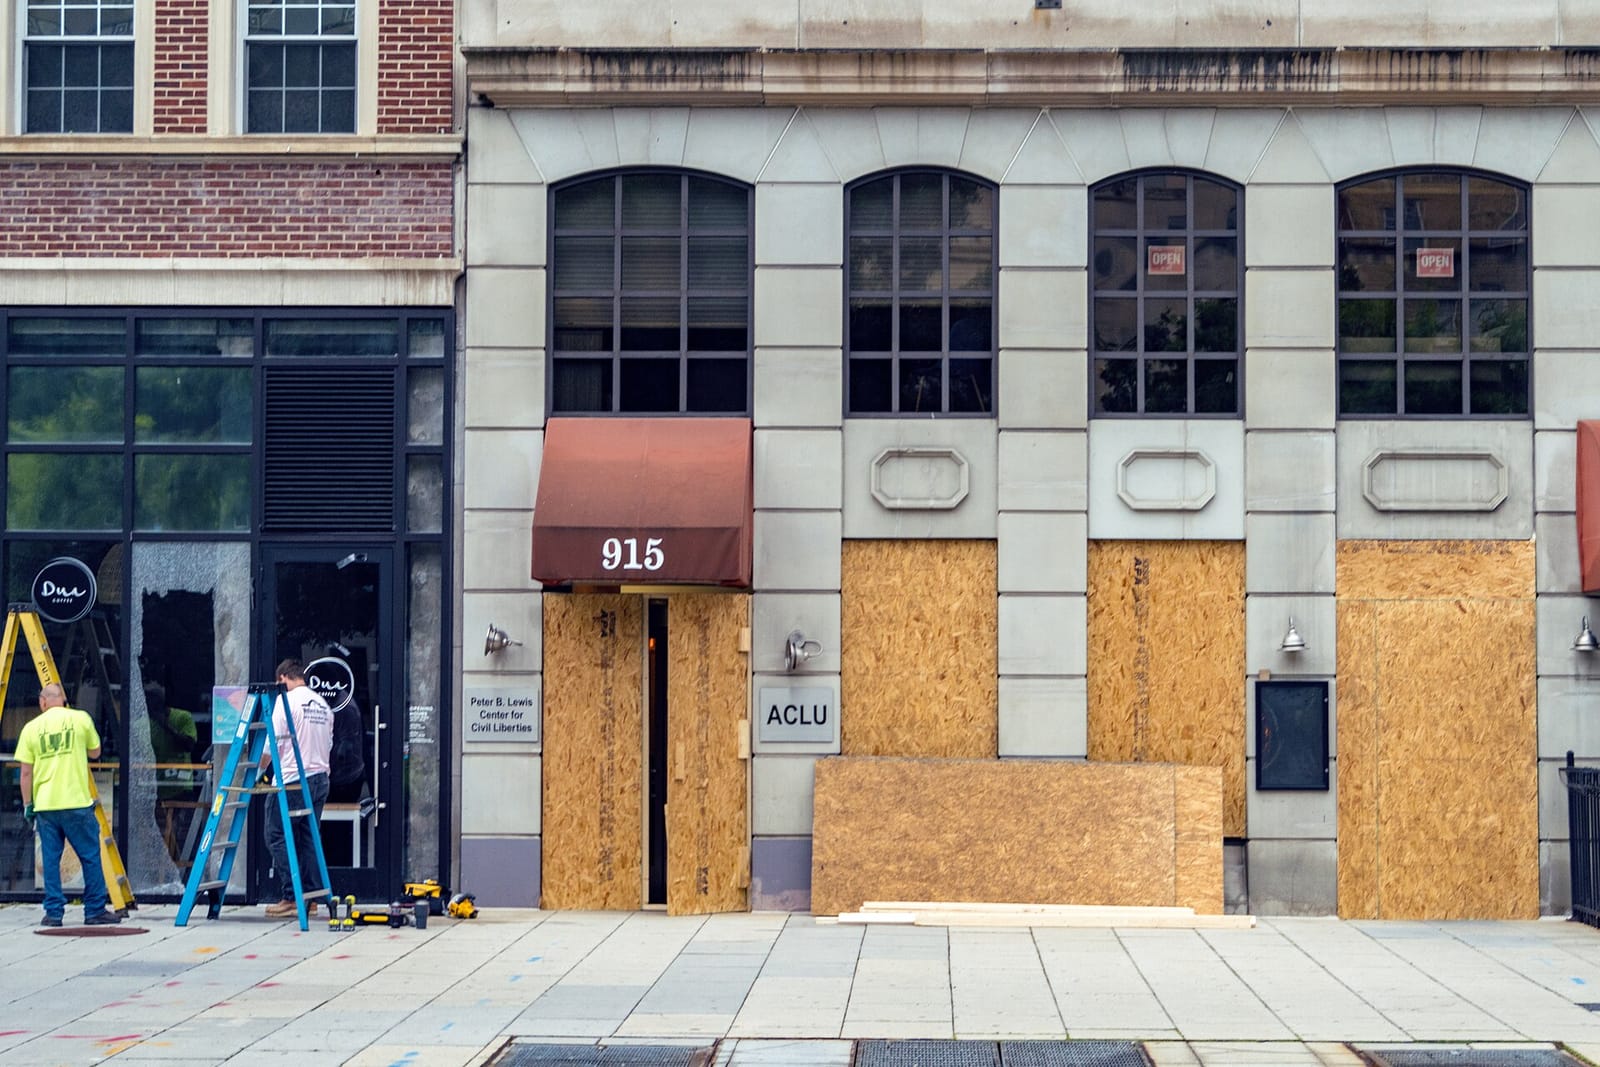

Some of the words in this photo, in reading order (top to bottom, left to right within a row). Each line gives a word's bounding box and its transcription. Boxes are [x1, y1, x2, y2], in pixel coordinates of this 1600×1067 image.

[1152, 252, 1181, 265] OPEN
[1421, 255, 1450, 267] OPEN
[602, 537, 664, 571] 915
[470, 697, 493, 707] Peter
[496, 697, 505, 707] B.
[507, 697, 533, 707] Lewis
[480, 709, 509, 720] Center
[511, 709, 524, 720] for
[766, 704, 827, 725] ACLU
[471, 722, 491, 733] Civil
[493, 722, 532, 733] Liberties
